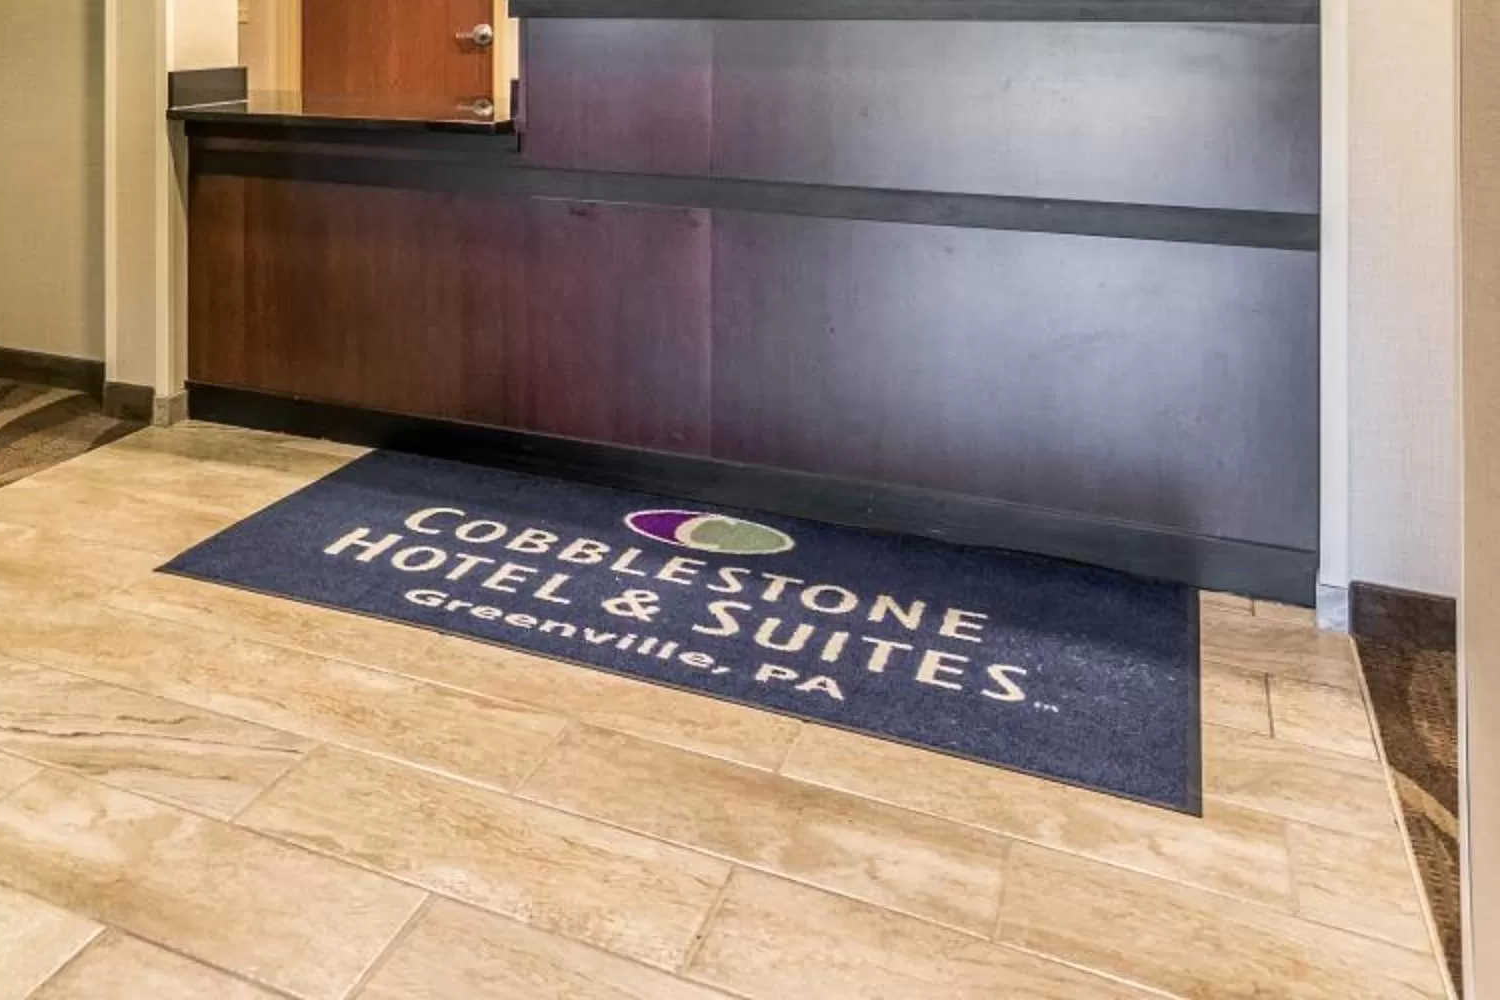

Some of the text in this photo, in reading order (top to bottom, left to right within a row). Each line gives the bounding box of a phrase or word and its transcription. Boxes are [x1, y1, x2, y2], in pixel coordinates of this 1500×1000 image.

[323, 526, 1028, 701] HOTEL & SUITES
[403, 506, 990, 643] COBBLESTONE
[403, 588, 845, 701] Greenville, PA
